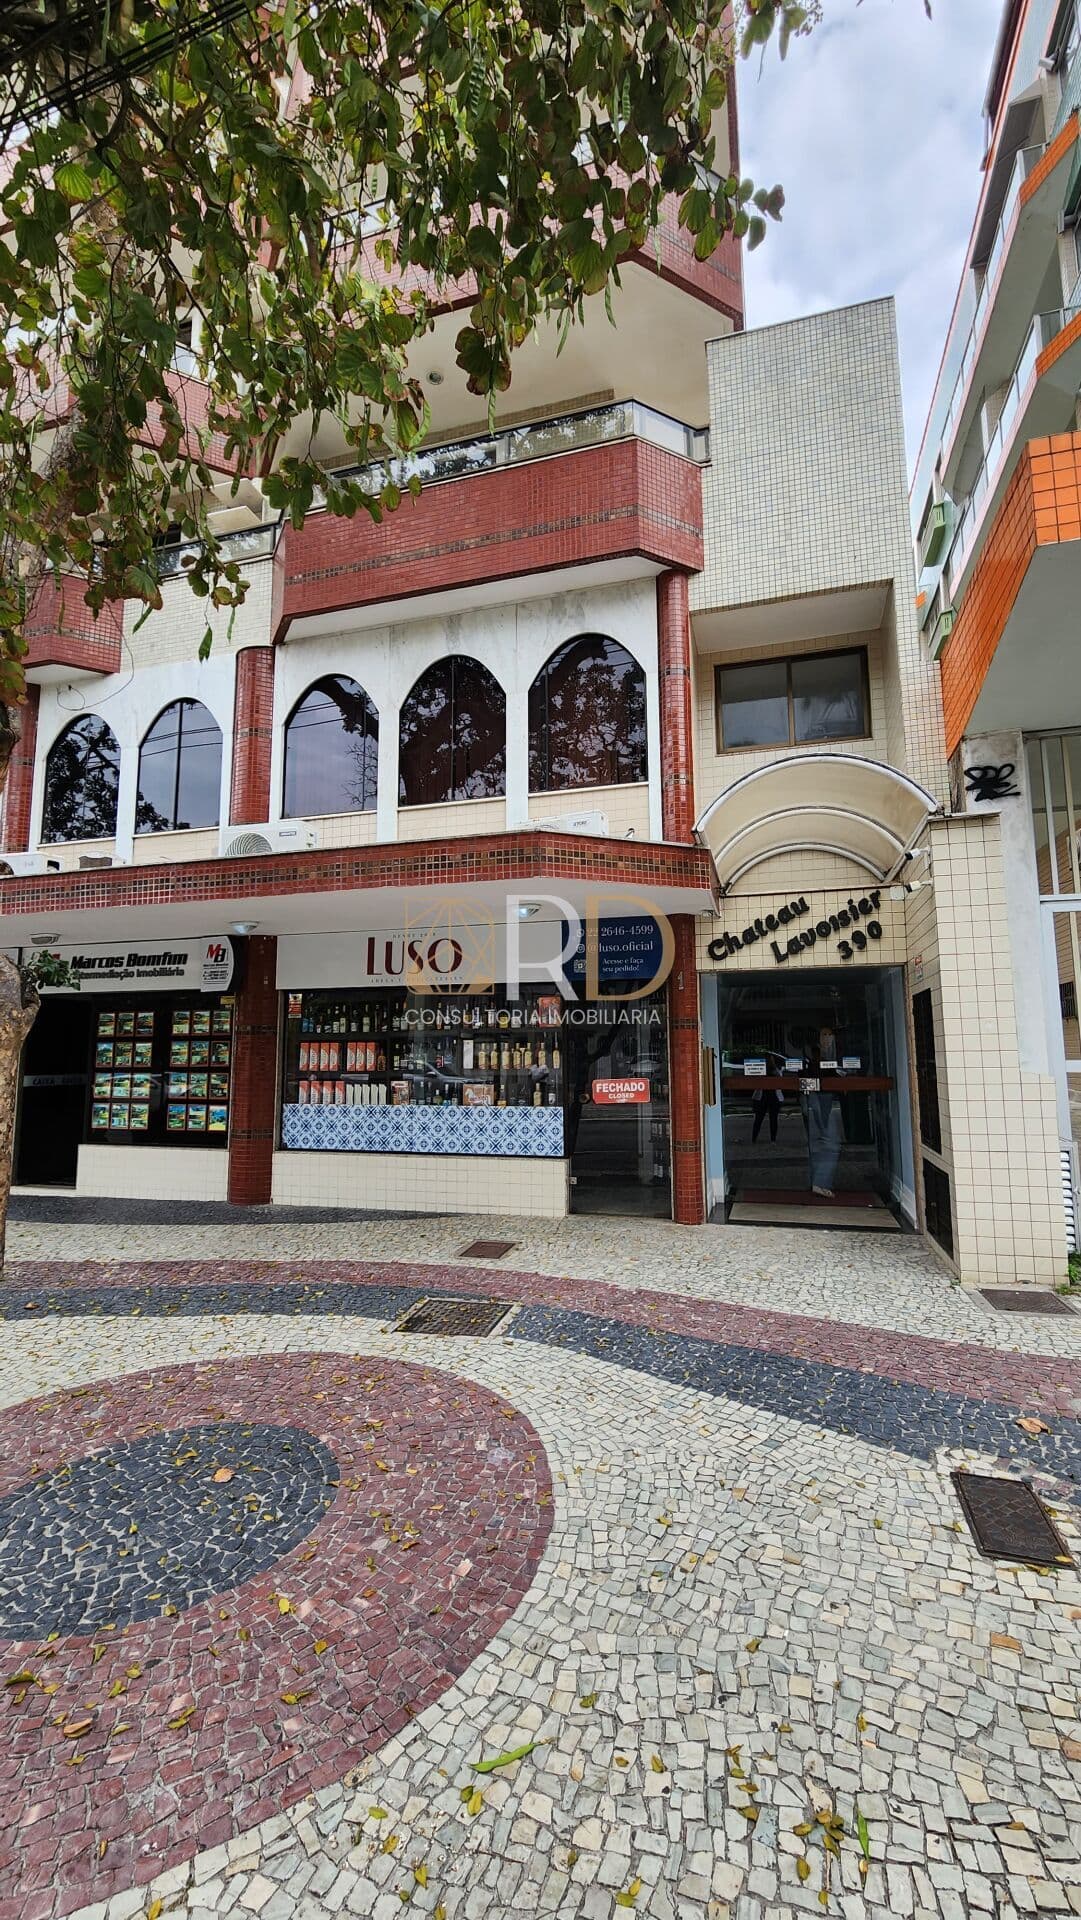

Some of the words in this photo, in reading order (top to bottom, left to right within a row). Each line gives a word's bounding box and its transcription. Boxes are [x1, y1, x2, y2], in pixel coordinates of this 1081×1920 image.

[601, 924, 654, 937] 2646-4599
[707, 896, 810, 961] Chateau
[837, 920, 882, 960] 390
[70, 955, 124, 969] Marcos
[126, 952, 188, 967] Bomfim
[367, 937, 463, 976] LUSO
[136, 967, 185, 979] Imobiliária
[595, 1082, 645, 1093] FECHADO
